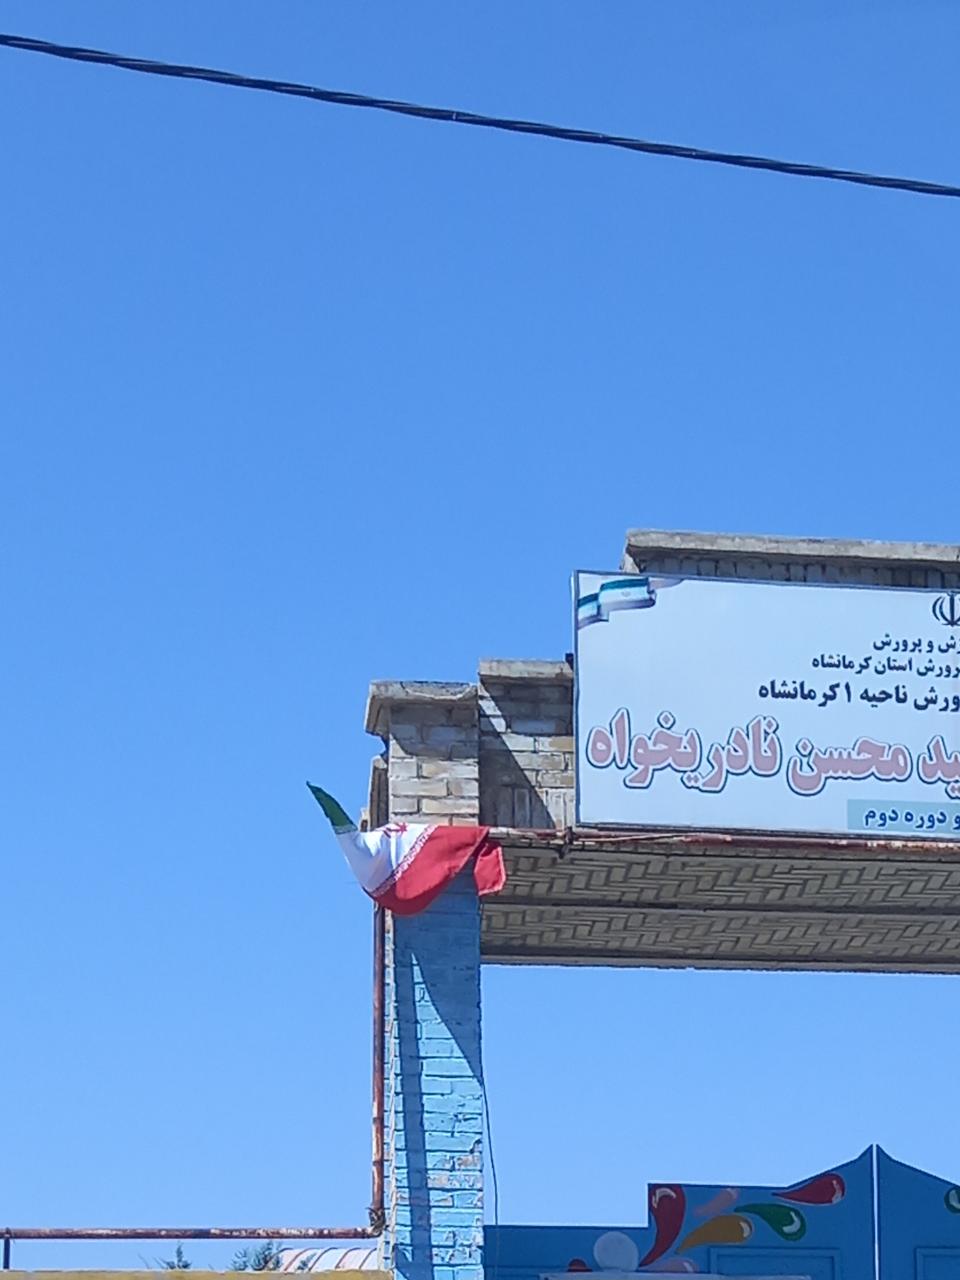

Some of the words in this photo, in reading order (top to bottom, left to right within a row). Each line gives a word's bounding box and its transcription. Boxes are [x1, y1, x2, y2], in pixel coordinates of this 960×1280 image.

[873, 633, 922, 653] پرورش
[927, 639, 935, 653] و
[811, 653, 873, 675] کرمانشاه
[874, 657, 913, 675] استان
[758, 679, 841, 707] کرمانشاه
[859, 684, 908, 708] ناحیه
[586, 708, 783, 793] نادریخواه
[786, 736, 913, 796] محسن
[863, 808, 899, 827] دوم
[904, 808, 947, 830] دوره
